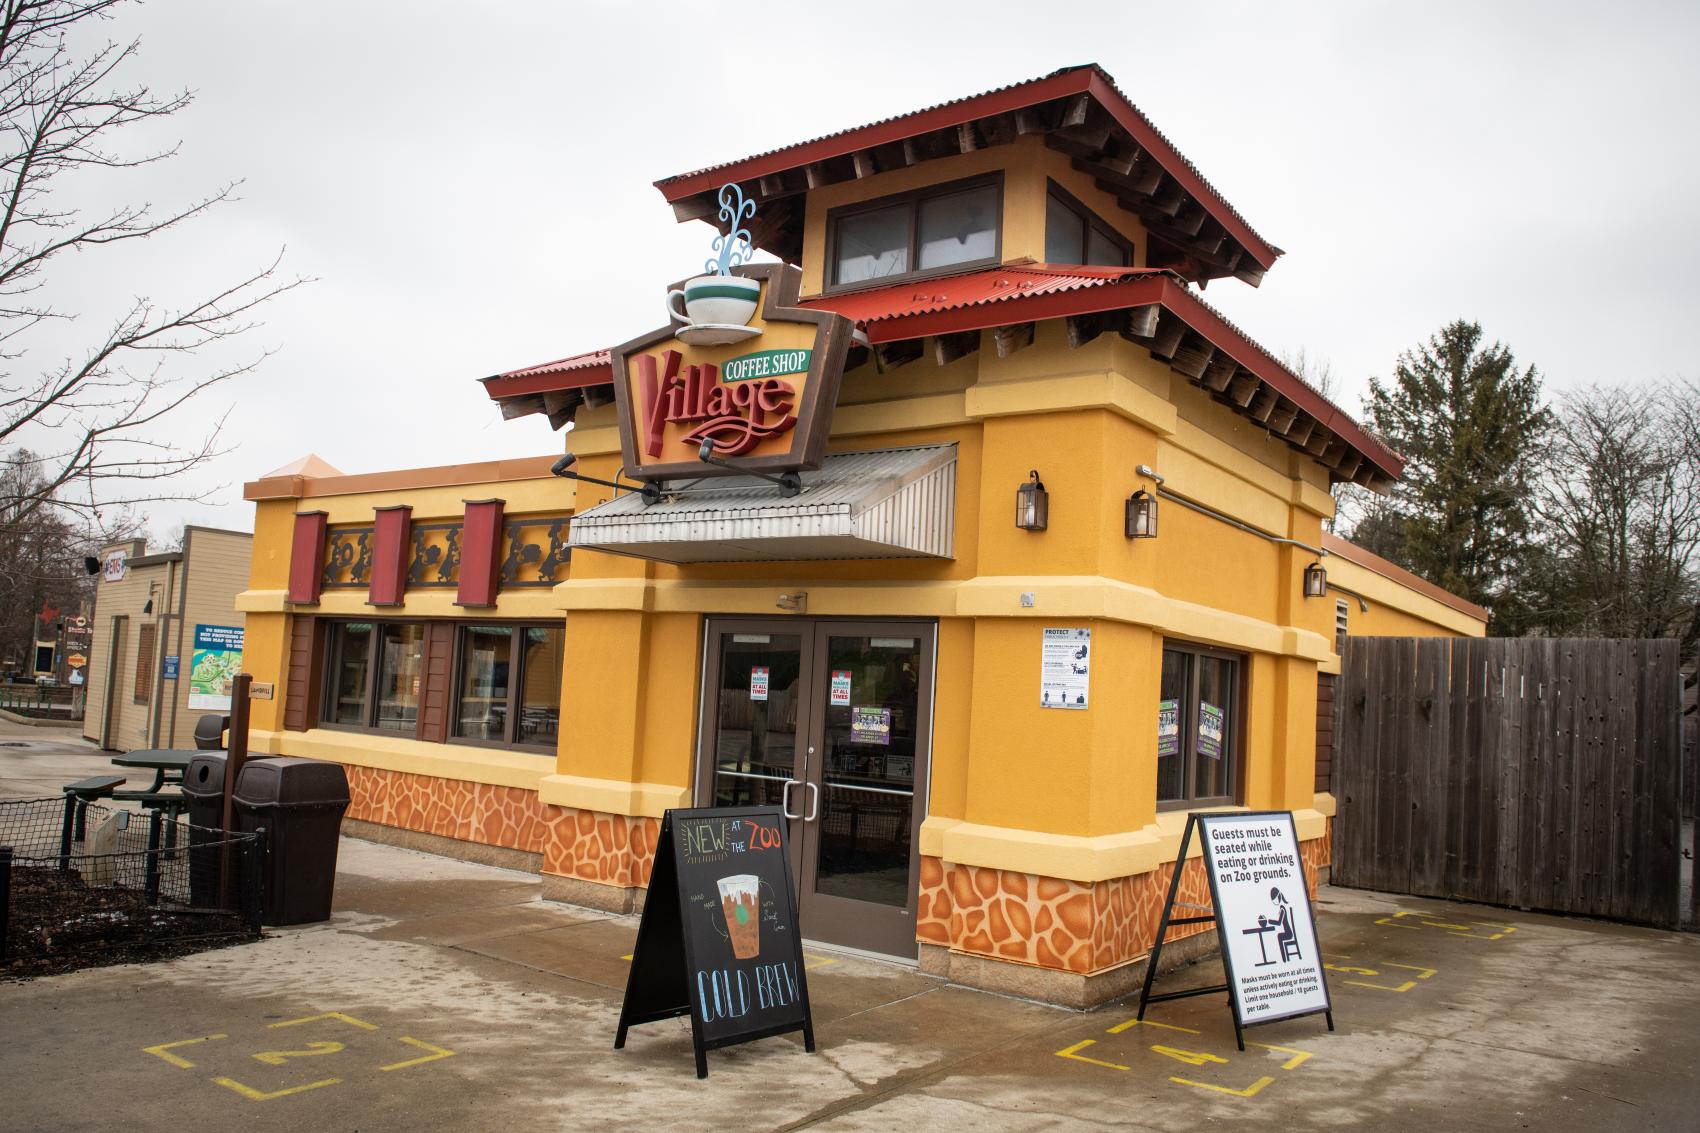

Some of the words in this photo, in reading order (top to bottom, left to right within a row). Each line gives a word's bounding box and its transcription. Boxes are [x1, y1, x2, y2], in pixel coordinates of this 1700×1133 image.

[725, 356, 770, 380] COFFEE
[771, 351, 806, 374] SHOP
[631, 350, 798, 458] Village
[687, 823, 725, 854] NEW
[731, 820, 741, 831] AT
[744, 820, 781, 851] ZOO
[1212, 828, 1244, 840] Guests
[1246, 827, 1269, 838] must
[1270, 826, 1282, 837] be
[731, 841, 746, 853] THE
[1215, 841, 1247, 855] seated
[1248, 840, 1272, 852] while
[1217, 856, 1248, 870] eating
[1248, 857, 1257, 866] or
[1259, 853, 1295, 867] drinking
[1220, 873, 1233, 883] on
[1234, 871, 1251, 882] Zoo
[1253, 867, 1292, 883] grounds.
[1241, 975, 1258, 984] Masks
[1243, 985, 1259, 993] unless
[1259, 982, 1278, 991] actively
[1278, 980, 1293, 988] eating
[697, 970, 751, 1023] COLD
[755, 960, 801, 1010] BREW
[1244, 995, 1259, 1003] Limit
[1268, 989, 1294, 998] household
[1303, 985, 1319, 994] guests
[1246, 1006, 1255, 1015] per
[1256, 1003, 1271, 1011] table.
[251, 1041, 346, 1065] 2
[1150, 1044, 1230, 1065] 4
